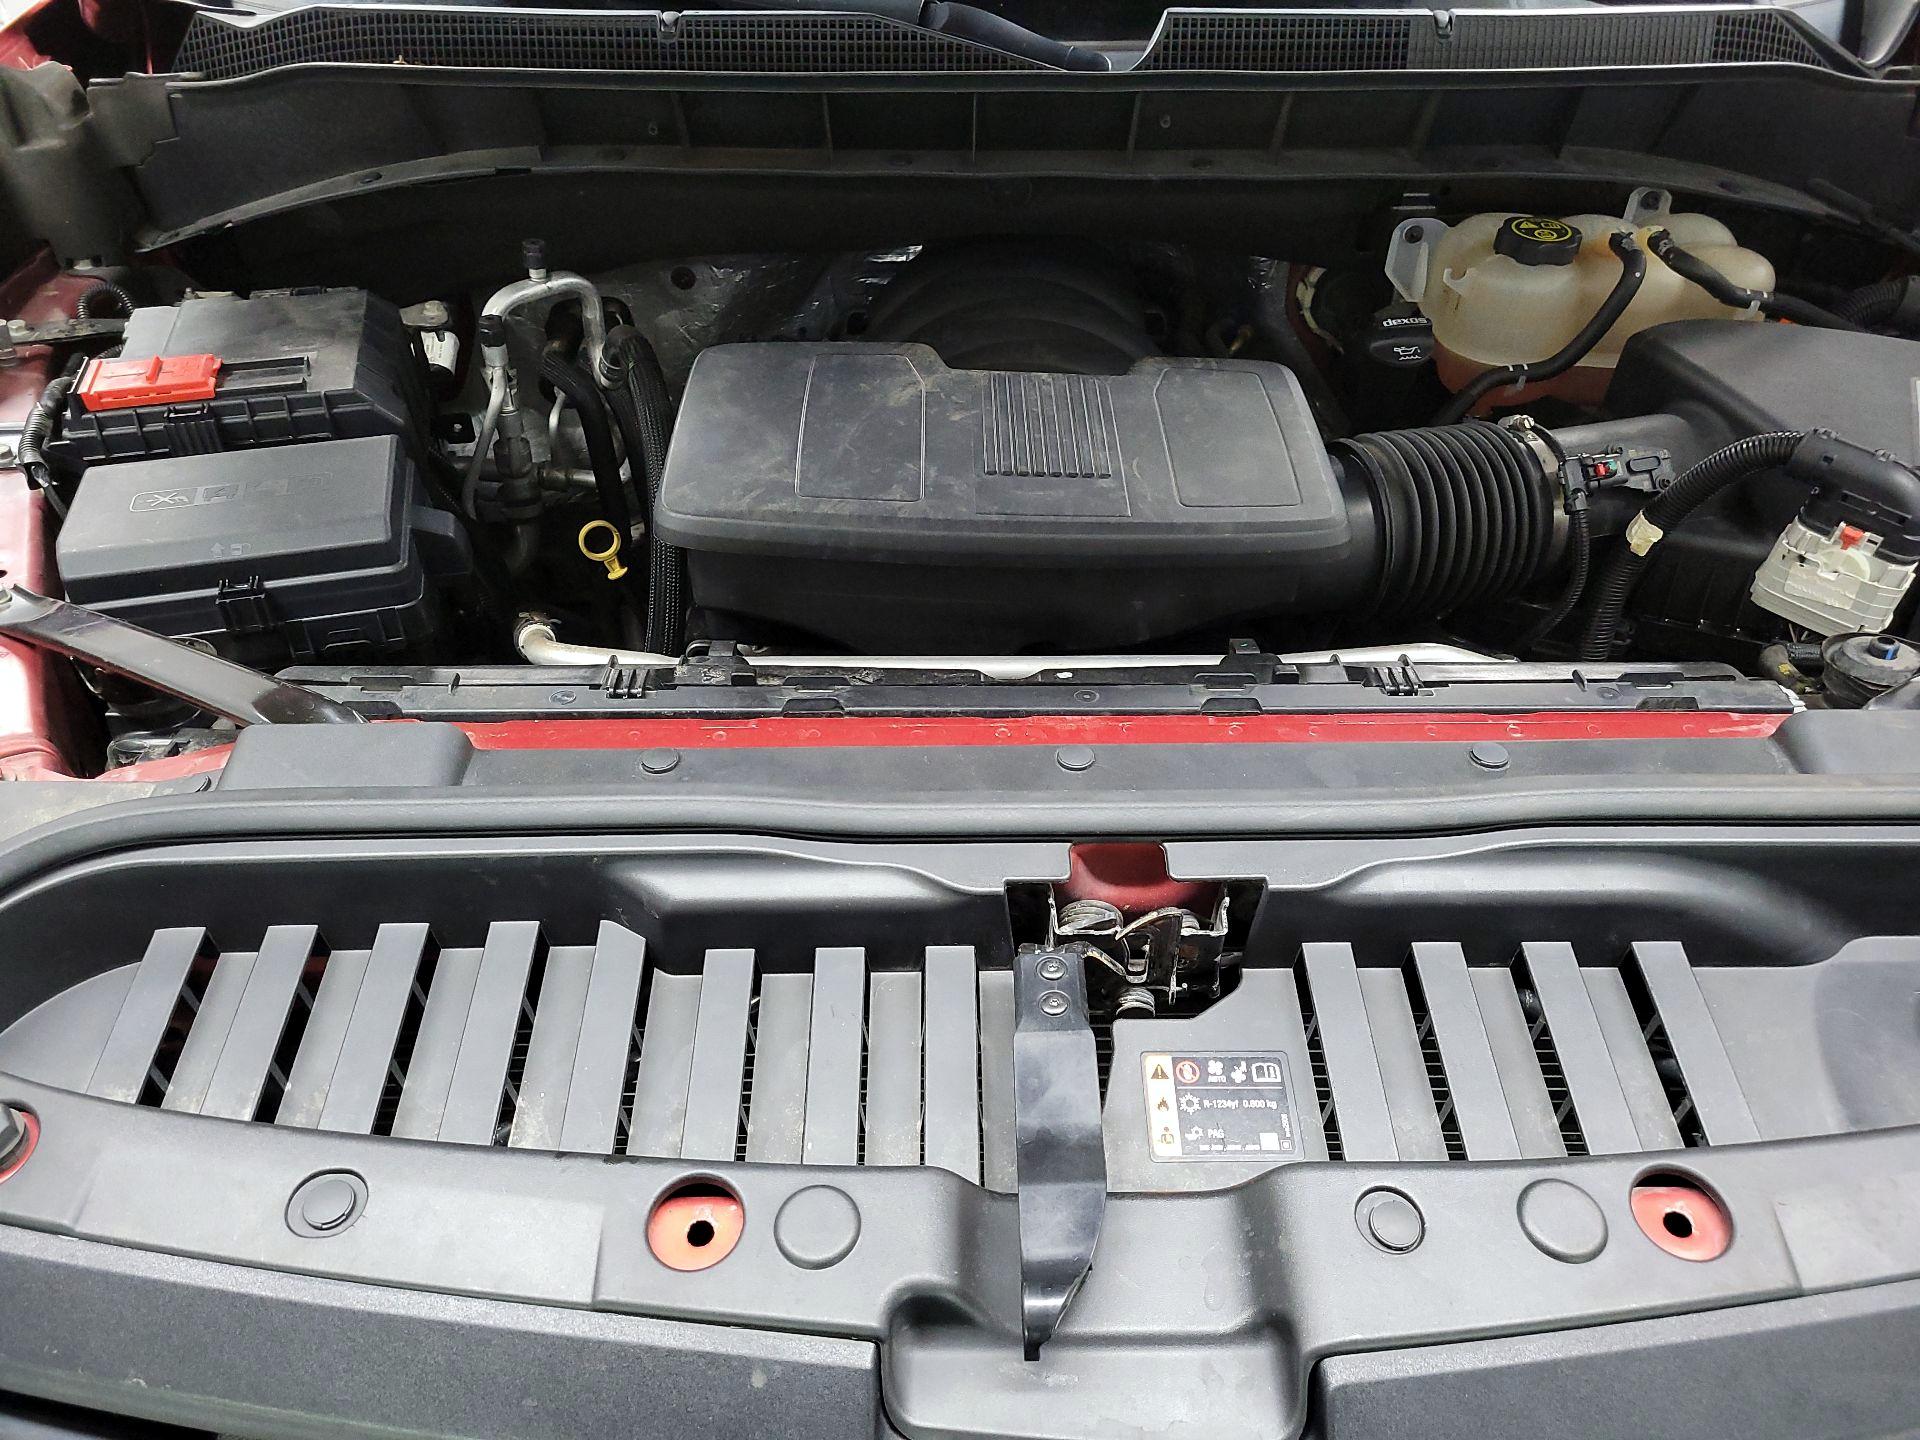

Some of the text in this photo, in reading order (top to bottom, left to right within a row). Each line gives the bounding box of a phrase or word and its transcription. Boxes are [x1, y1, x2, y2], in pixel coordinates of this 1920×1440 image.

[1382, 317, 1428, 327] dexos
[1266, 1099, 1278, 1110] kg
[1207, 1128, 1225, 1139] PAG
